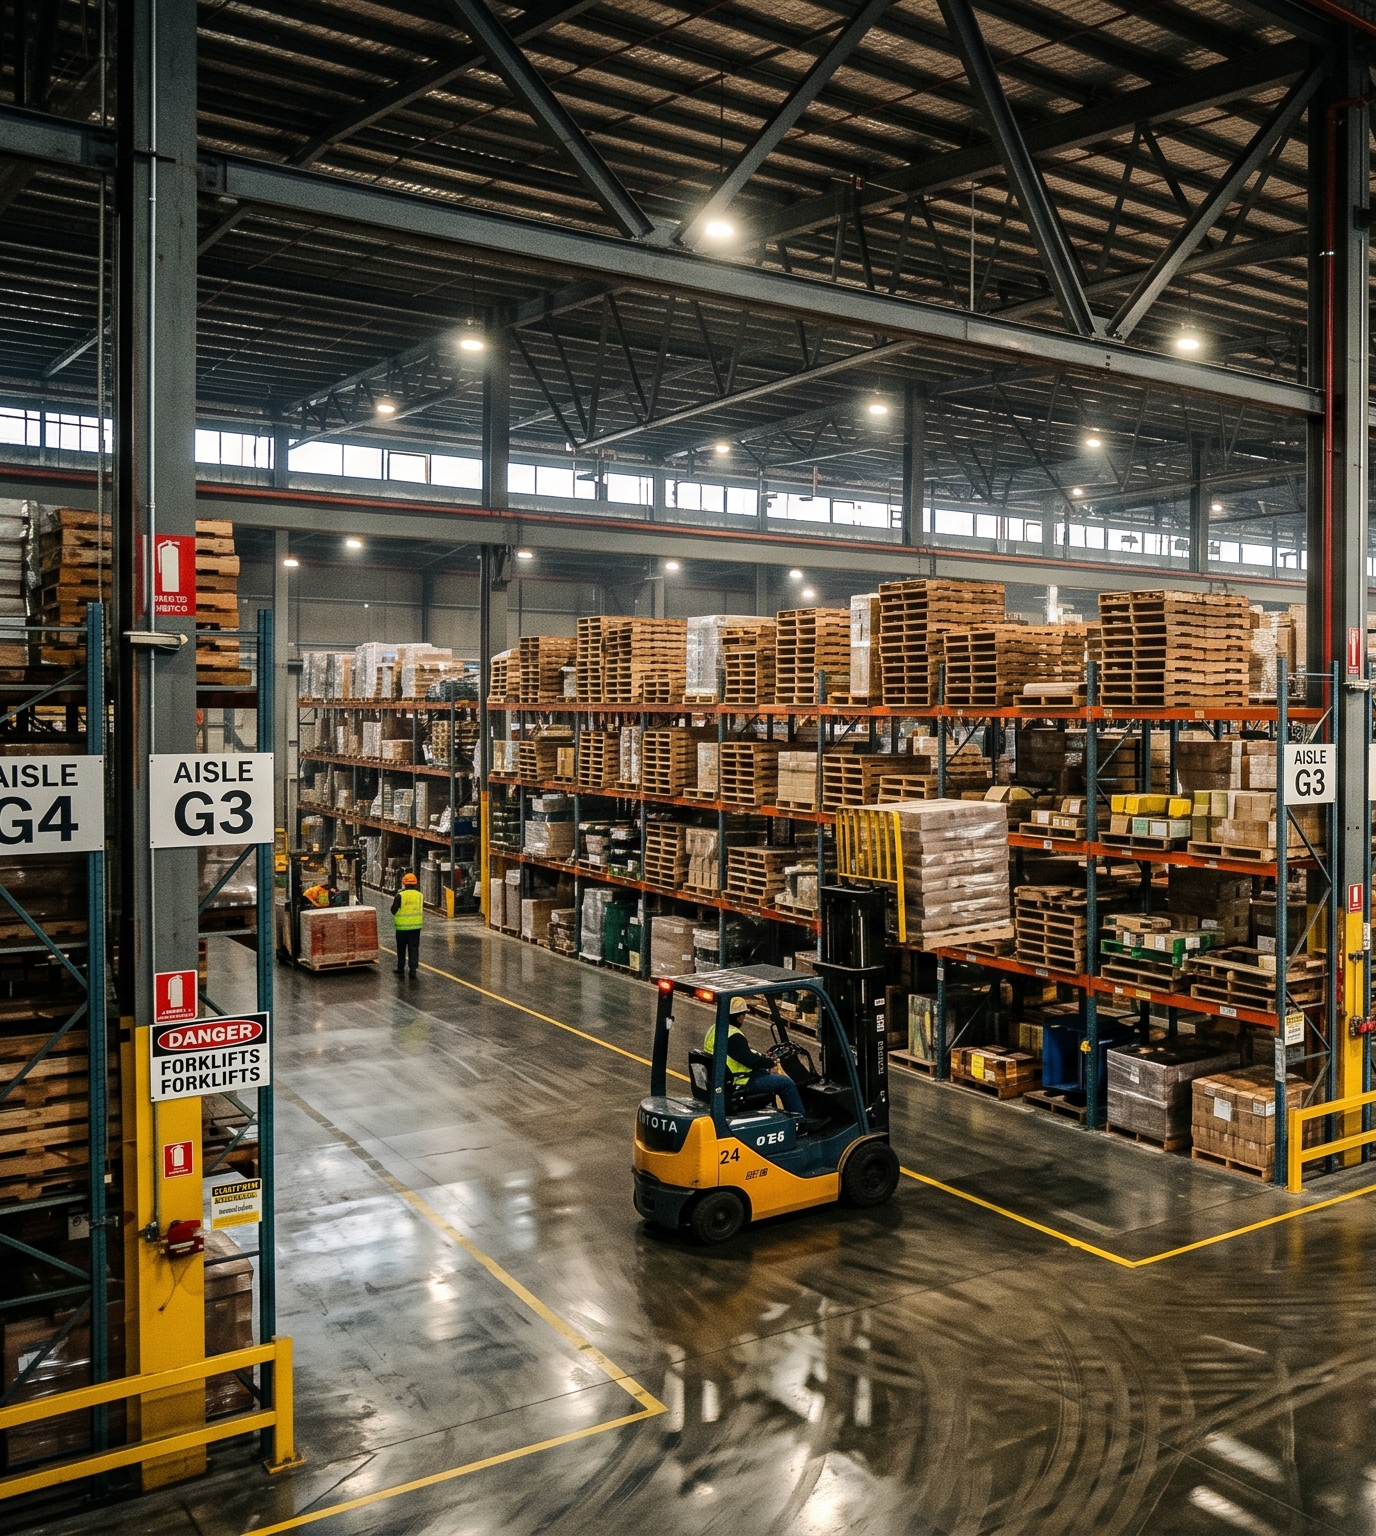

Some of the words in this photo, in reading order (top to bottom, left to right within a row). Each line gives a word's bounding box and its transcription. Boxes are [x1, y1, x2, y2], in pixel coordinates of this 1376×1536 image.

[173, 760, 254, 783] AISLE
[1294, 750, 1327, 765] AISLE
[1295, 769, 1326, 797] G3
[0, 796, 79, 845] G4
[174, 790, 254, 836] G3
[168, 1024, 253, 1048] DANGER
[161, 1048, 260, 1076] FORKLIFTS
[161, 1067, 261, 1095] FORKLIFTS
[719, 1147, 741, 1165] 24
